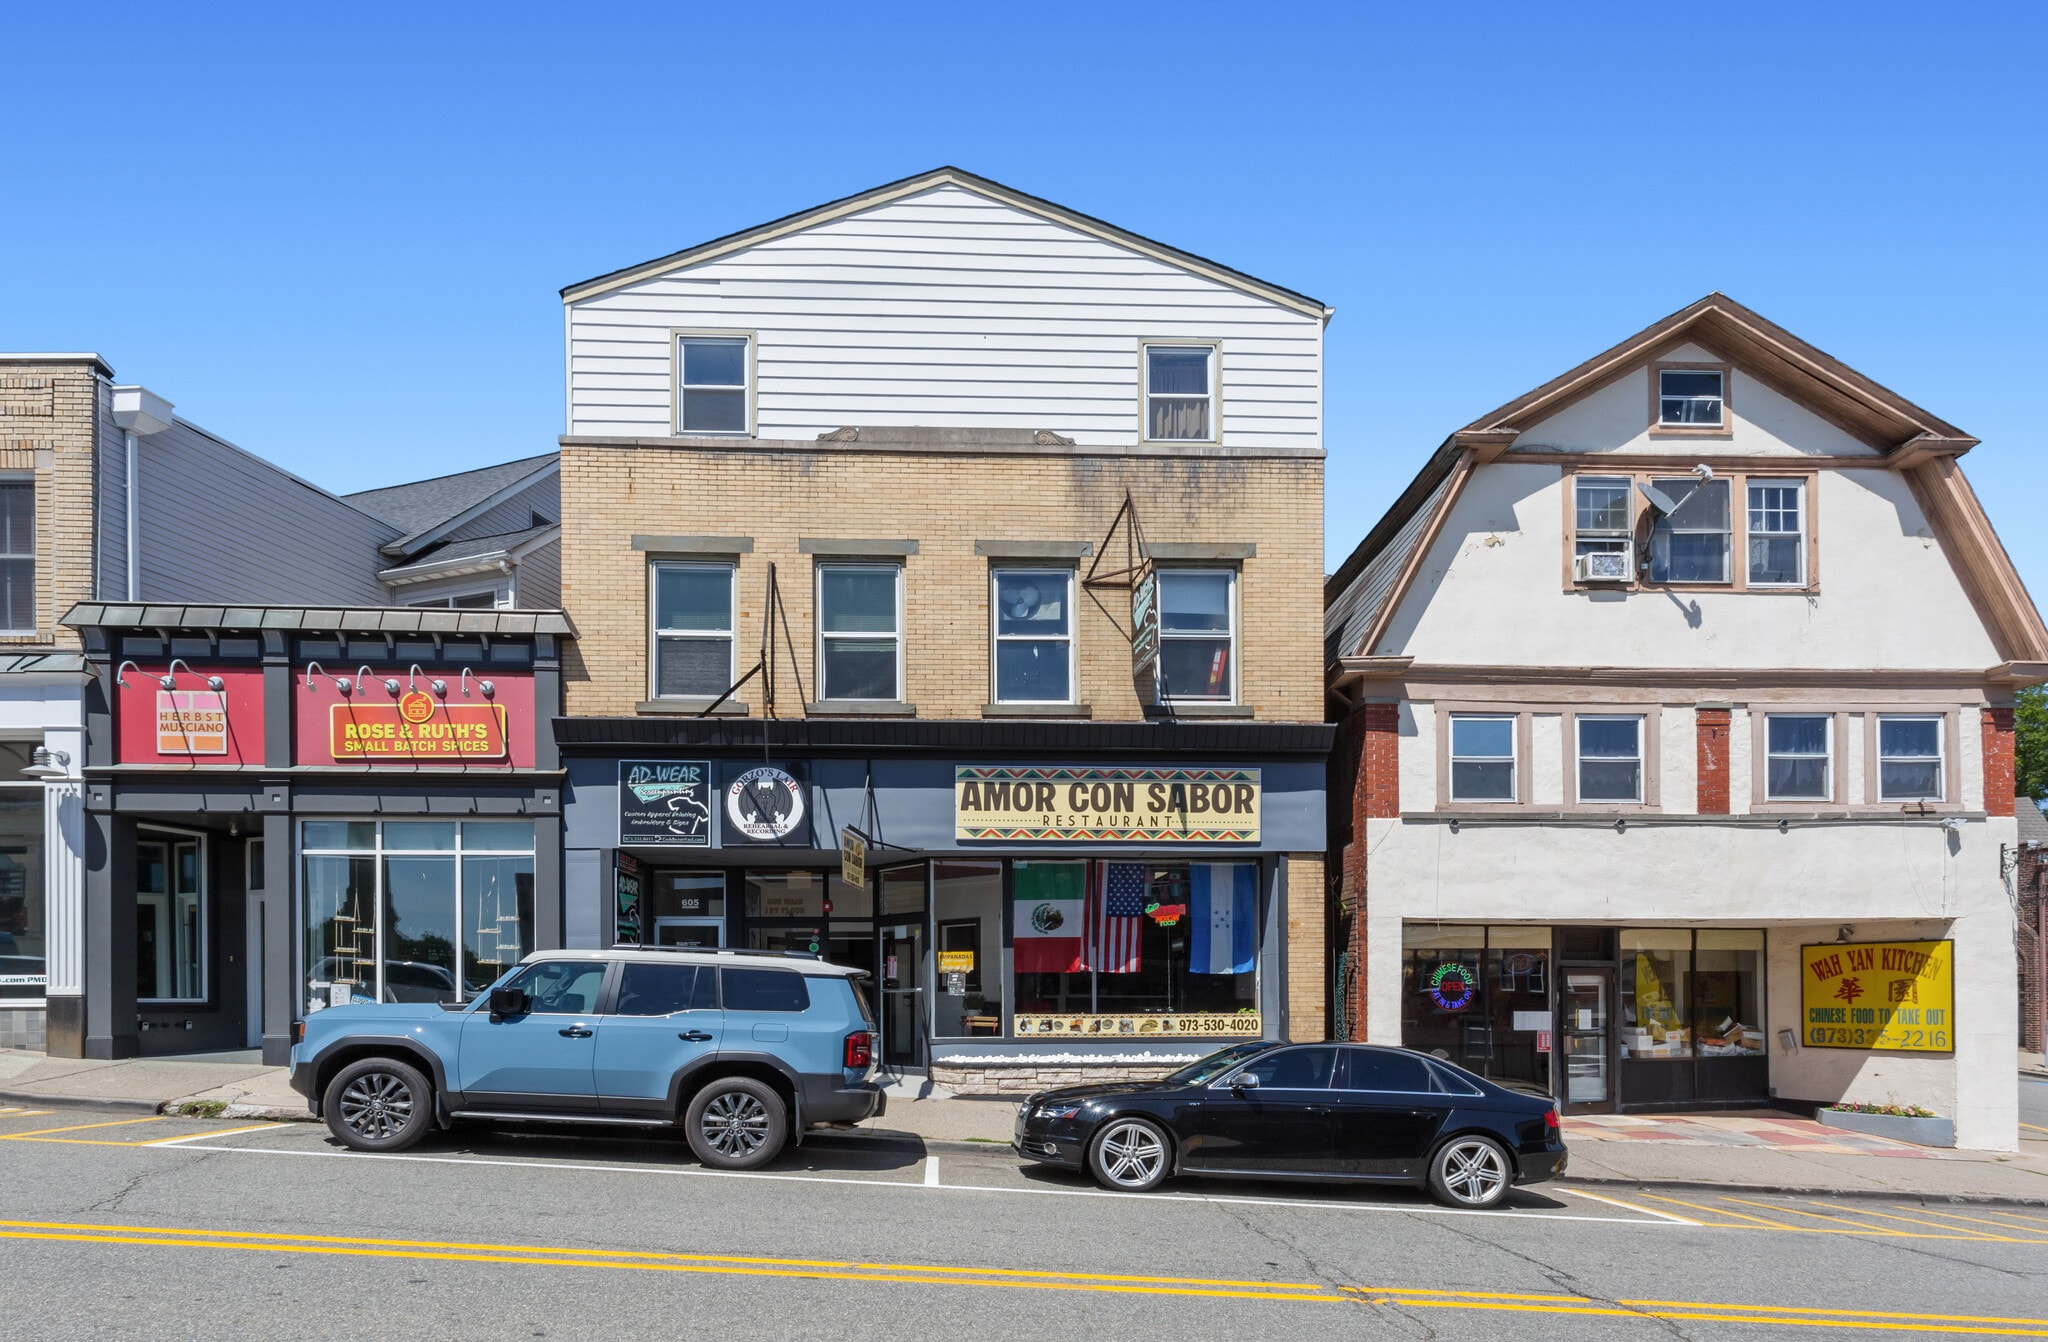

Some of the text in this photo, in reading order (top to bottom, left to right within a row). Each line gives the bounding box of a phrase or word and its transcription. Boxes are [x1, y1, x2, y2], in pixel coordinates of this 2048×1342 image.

[160, 712, 223, 721] HERBST
[160, 723, 224, 732] MUSCIANO
[345, 723, 488, 739] ROSE & RUTH'S
[345, 741, 489, 752] SMALL BATCH SPICES
[628, 765, 701, 783] AD-WEAR
[731, 768, 799, 796] GORZO'S LAIR
[960, 781, 1255, 814] AMOR CON SABOR
[1043, 815, 1172, 827] RESTAURANT
[682, 898, 699, 906] 605
[1810, 947, 1943, 982] WAH YAN KITCHEN
[1431, 963, 1473, 986] CHINESE FOOD
[1441, 981, 1466, 992] OPEN
[1431, 987, 1441, 999] EAT
[1438, 997, 1446, 1006] IN
[1451, 997, 1466, 1009] TAKE
[1463, 987, 1473, 1000] OUT
[1809, 1007, 1946, 1025] CHINESE FOOD TO TAKE OUT
[1179, 1019, 1258, 1031] 973-530-4020
